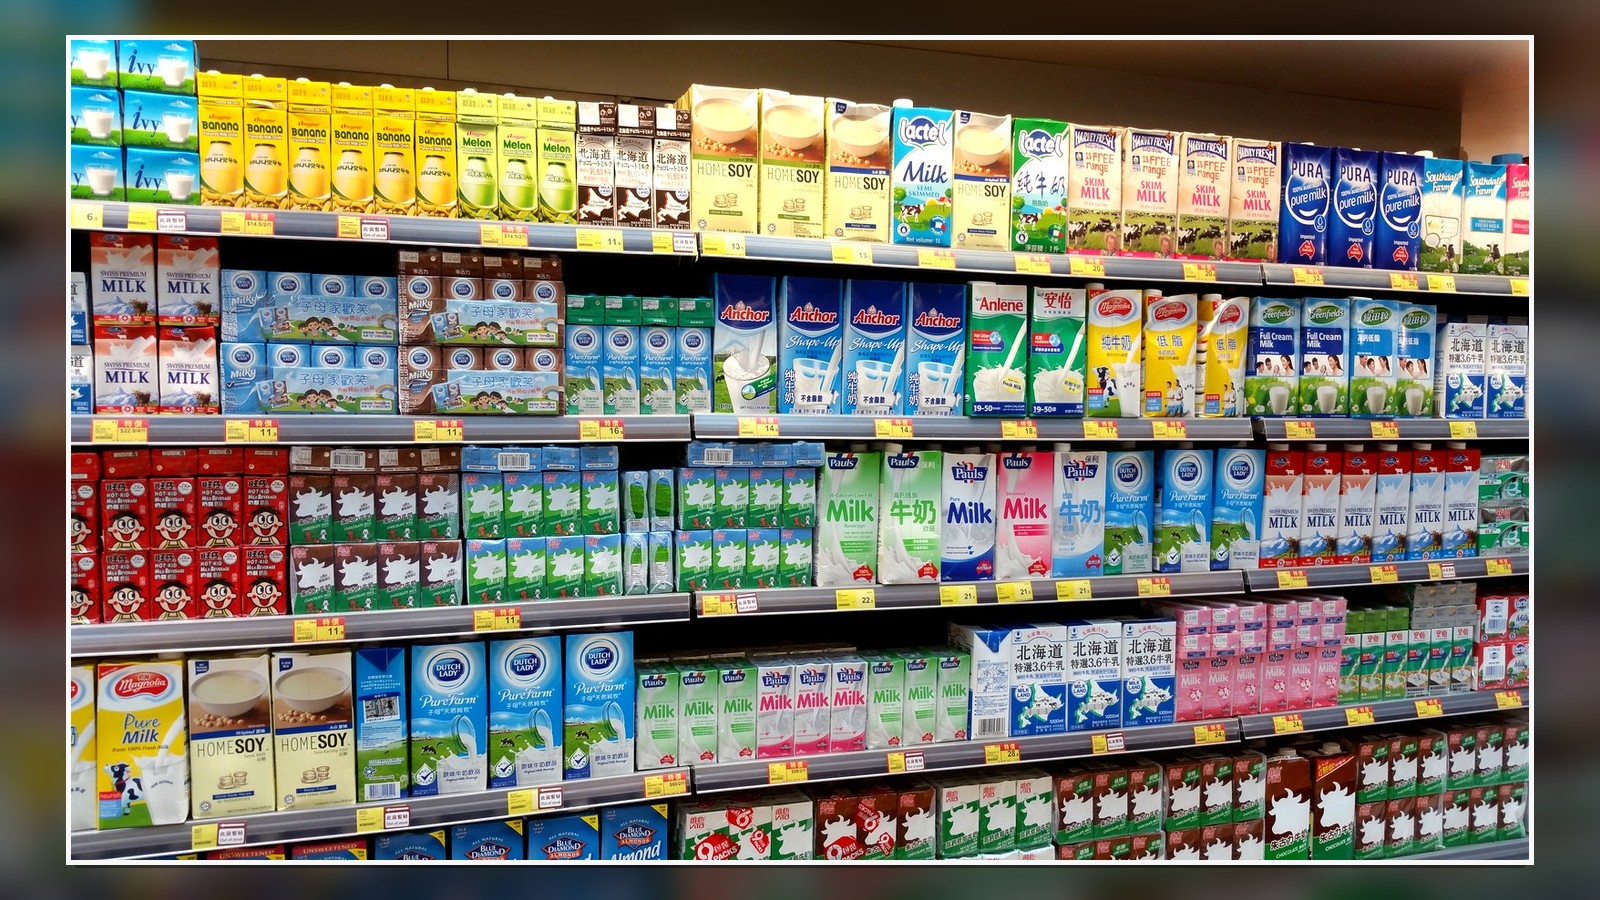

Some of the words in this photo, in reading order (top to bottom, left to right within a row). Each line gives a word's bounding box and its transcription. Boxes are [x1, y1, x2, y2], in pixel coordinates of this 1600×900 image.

[128, 49, 157, 80] ivy
[133, 106, 162, 137] ivy
[900, 119, 947, 146] lactel
[463, 137, 491, 147] Melon
[504, 140, 531, 150] Melon
[1019, 130, 1063, 157] lactel
[1075, 131, 1095, 147] HARVEY
[1096, 132, 1115, 150] FRESH
[544, 143, 570, 153] Melon
[580, 148, 610, 160] 北海道
[617, 151, 648, 162] 北海道
[135, 164, 163, 190] ivy
[903, 161, 948, 184] Milk
[1292, 162, 1323, 178] PURA
[1340, 165, 1371, 183] PURA
[1085, 177, 1104, 186] SKIM
[1387, 169, 1417, 186] PURA
[1141, 181, 1161, 189] SKIM
[1196, 185, 1216, 194] SKIM
[909, 190, 940, 198] SKIMMED
[1081, 186, 1110, 200] MILK
[1137, 190, 1167, 203] MILK
[1192, 193, 1221, 207] MILK
[1247, 190, 1266, 198] SKIM
[1291, 194, 1308, 208] pure
[1309, 188, 1326, 202] milk
[1243, 199, 1272, 211] MILK
[1339, 195, 1357, 211] pure
[1357, 190, 1375, 204] milk
[1385, 199, 1403, 215] pure
[1403, 195, 1420, 207] milk
[102, 280, 146, 292] MILK
[168, 281, 210, 294] MILK
[980, 297, 1023, 311] Anlene
[1044, 292, 1071, 309] 安怡
[721, 306, 769, 321] Anchor
[790, 307, 837, 322] Anchor
[853, 310, 900, 325] Anchor
[915, 312, 961, 328] Anchor
[786, 336, 842, 348] Shape-Up
[1102, 335, 1131, 350] 纯牛奶
[1260, 332, 1270, 340] Full
[1272, 333, 1292, 341] Cream
[1307, 332, 1318, 340] Full
[1319, 333, 1341, 341] Cream
[849, 338, 904, 351] Shape-Up
[911, 341, 965, 353] Shape-Up
[1451, 339, 1483, 352] 北海道
[1492, 340, 1525, 353] 北海道
[105, 371, 149, 383] MILK
[168, 372, 210, 384] MILK
[830, 458, 854, 467] Pauls
[890, 458, 915, 466] Pauls
[1006, 458, 1028, 467] Pauls
[956, 469, 983, 479] Pauls
[1067, 468, 1094, 477] Pauls
[827, 499, 874, 522] Milk
[890, 499, 936, 525] 牛奶
[947, 502, 992, 524] Milk
[1003, 498, 1047, 520] Milk
[1059, 499, 1100, 524] 牛奶
[1269, 517, 1298, 528] MILK
[1307, 515, 1335, 527] MILK
[1344, 515, 1371, 527] MILK
[1016, 644, 1063, 661] 北海道
[1017, 644, 1063, 661] 北海道
[1073, 640, 1118, 657] 北海道
[1128, 638, 1172, 654] 北海道
[514, 658, 537, 666] DUTCH
[588, 652, 610, 660] DUTCH
[1071, 657, 1120, 669] 特選3.6牛乳
[1126, 654, 1174, 666] 特選3.6牛乳
[439, 670, 458, 678] LADY
[517, 664, 535, 672] LADY
[1014, 661, 1065, 673] 特選3.6牛乳
[1014, 661, 1065, 673] 特選3.6牛乳
[119, 678, 166, 693] Magnolia
[574, 680, 625, 695] PureFarm
[420, 693, 477, 708] PureFarm
[498, 687, 553, 702] PureFarm
[797, 693, 829, 709] Milk
[834, 690, 865, 706] Milk
[873, 690, 900, 704] Milk
[684, 701, 714, 717] Milk
[724, 699, 753, 714] Milk
[760, 694, 792, 711] Milk
[644, 705, 675, 720] Milk
[124, 714, 160, 729] Pure
[122, 729, 158, 744] Milk
[547, 844, 580, 853] DIAMOND
[556, 840, 569, 848] BLUE
[472, 849, 506, 858] DIAMOND
